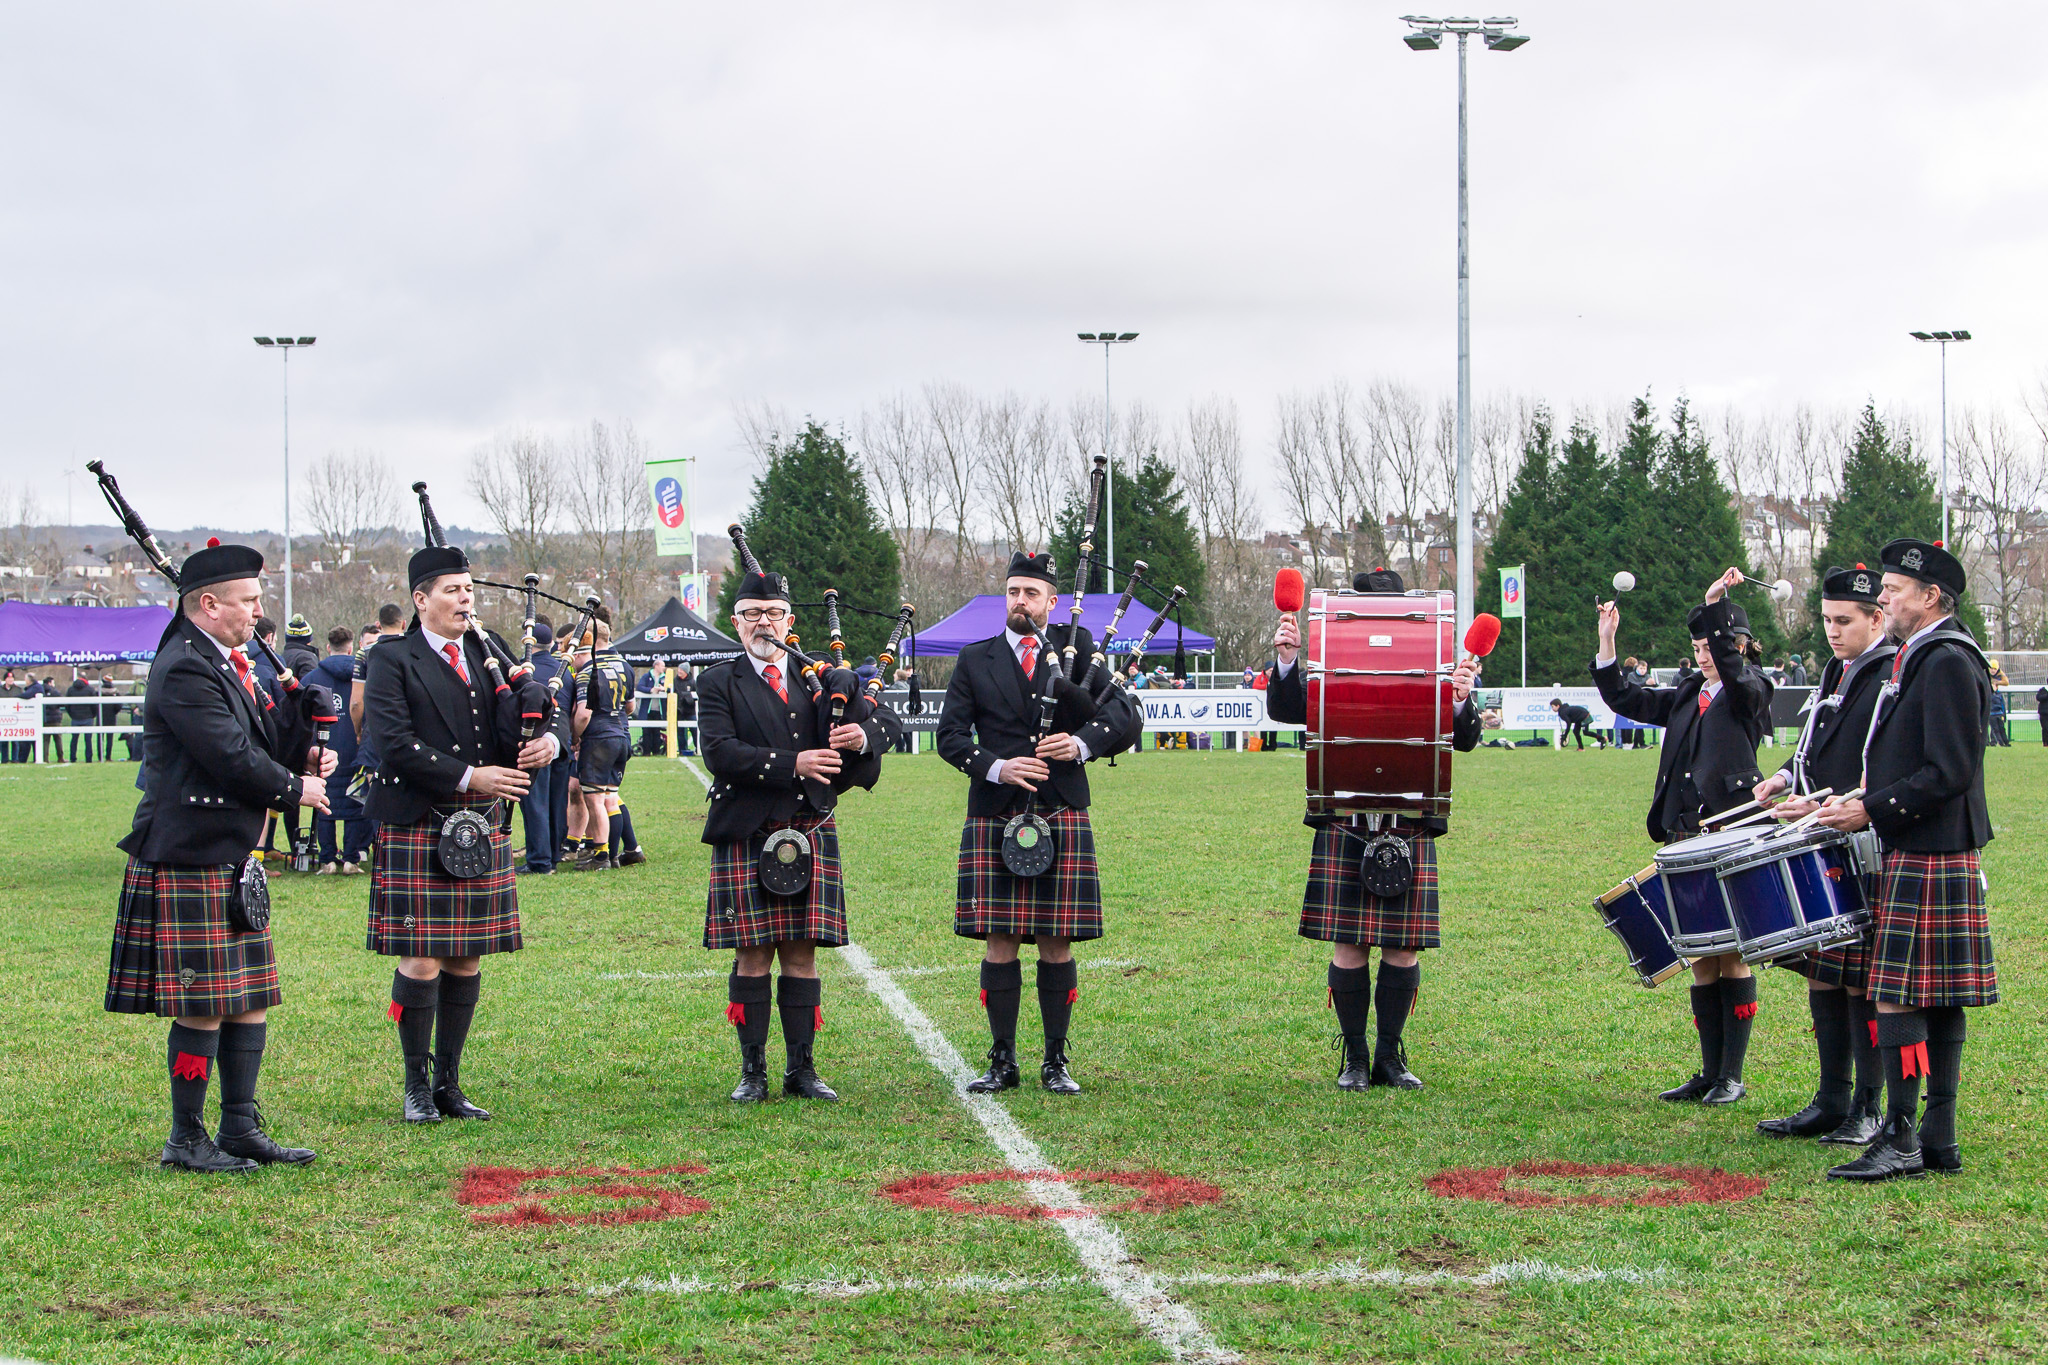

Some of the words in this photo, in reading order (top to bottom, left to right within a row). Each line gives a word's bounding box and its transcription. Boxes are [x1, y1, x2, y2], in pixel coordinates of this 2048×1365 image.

[672, 626, 707, 638] GHA
[53, 650, 116, 662] Triathlon
[625, 653, 651, 662] Rugby
[652, 653, 671, 662] Club
[1146, 703, 1186, 719] W.A.A.
[1216, 702, 1253, 719] EDDIE
[1516, 714, 1545, 722] FOOD
[4, 728, 35, 737] 232999
